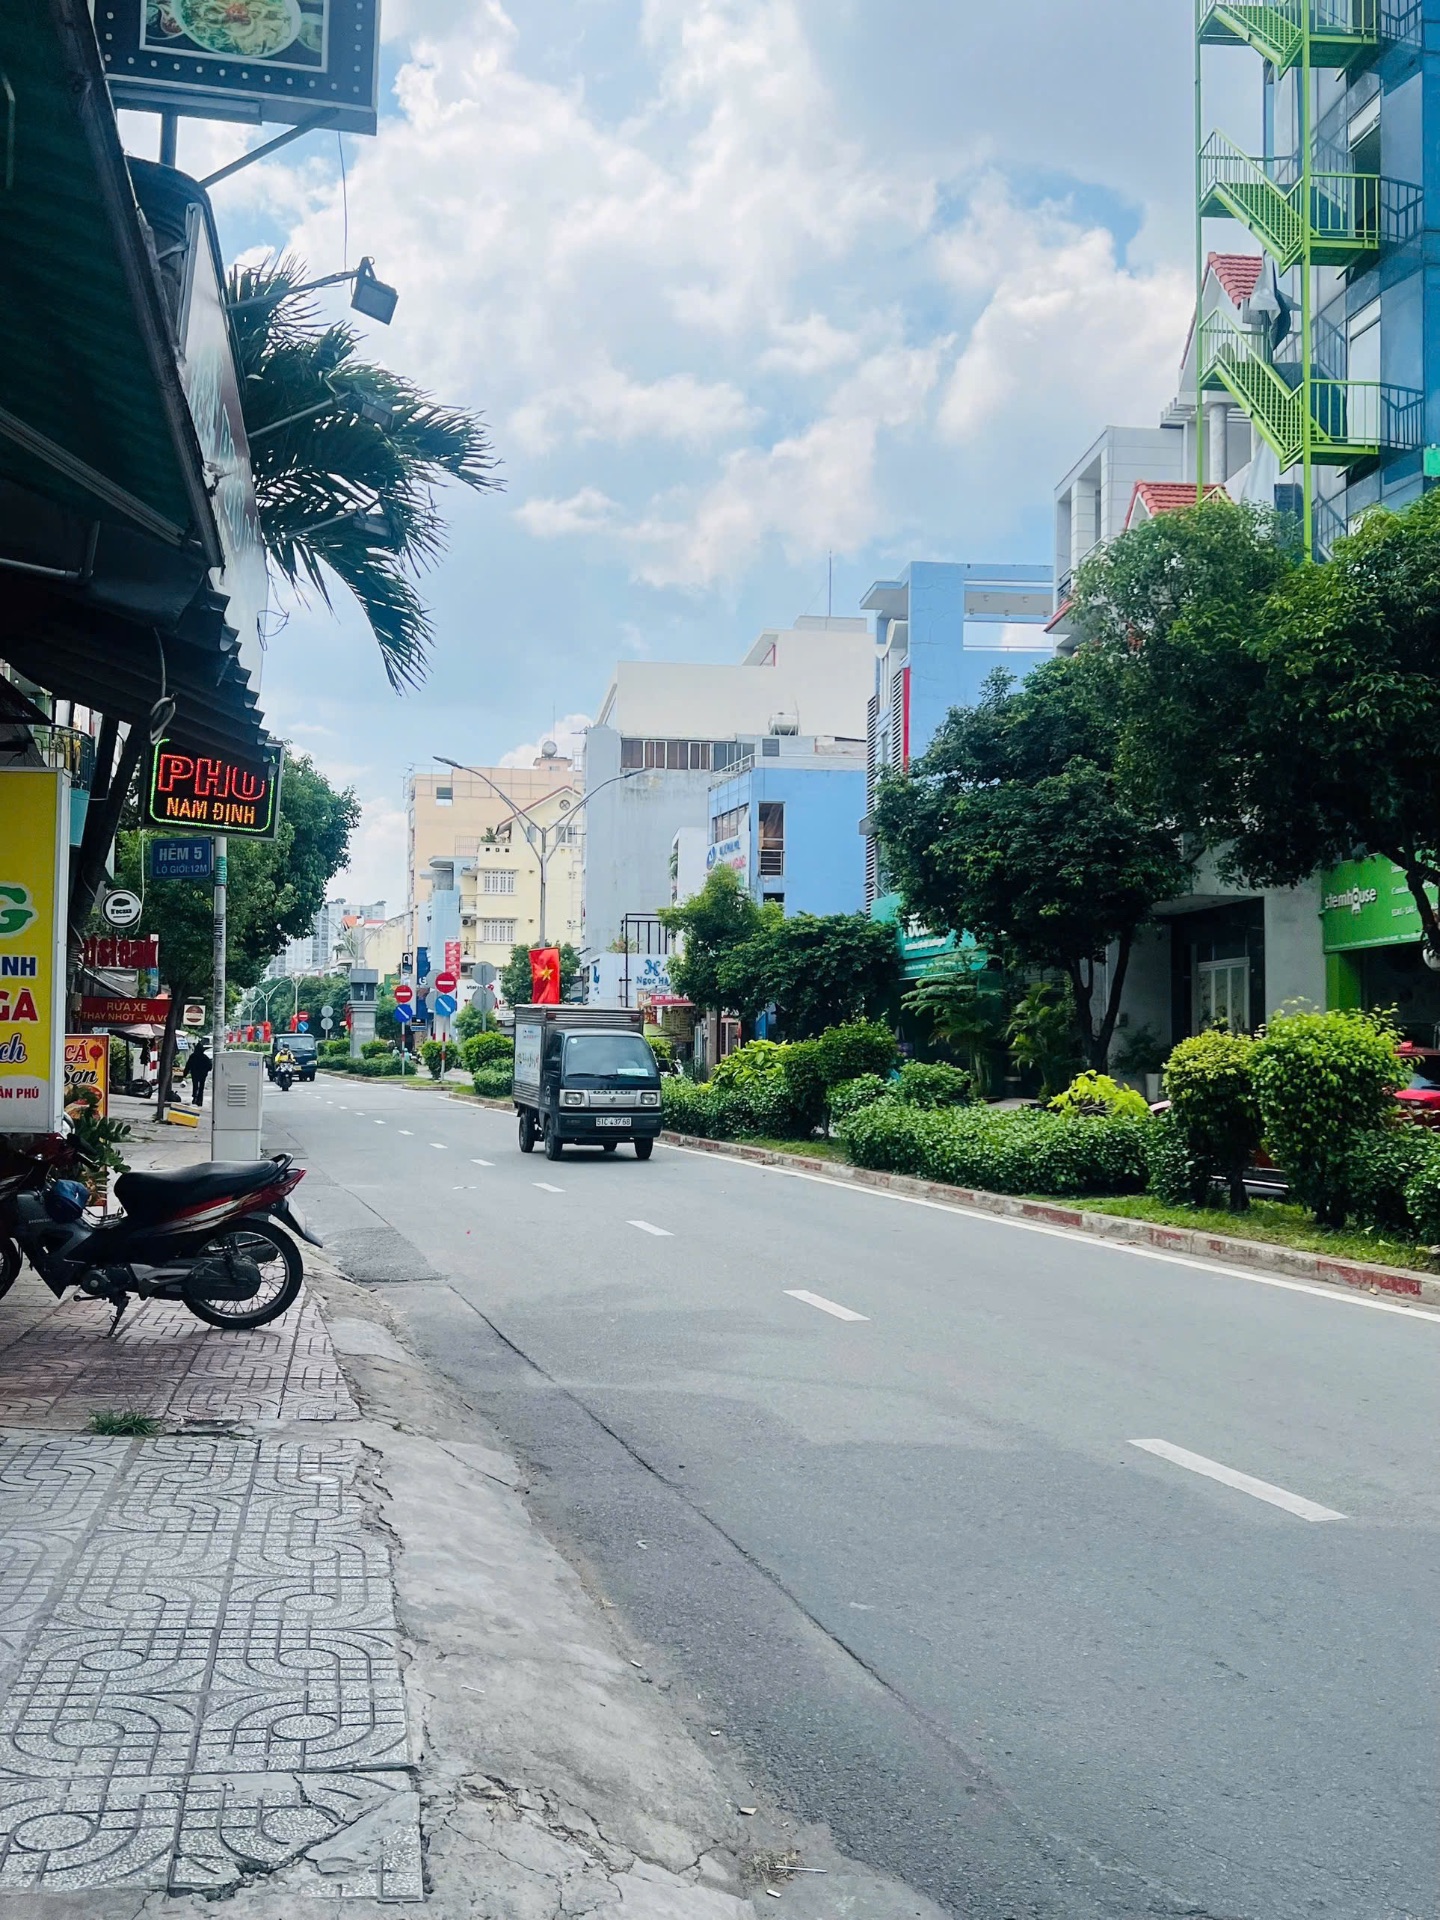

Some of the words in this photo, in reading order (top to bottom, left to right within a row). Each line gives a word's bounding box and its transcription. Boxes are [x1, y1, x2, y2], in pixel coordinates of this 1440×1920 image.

[166, 797, 208, 820] NAM
[212, 802, 255, 825] ĐỊNH
[194, 846, 203, 860] 5
[133, 1003, 148, 1012] XE
[83, 1012, 106, 1020] THAY
[16, 1086, 39, 1099] PHÚ
